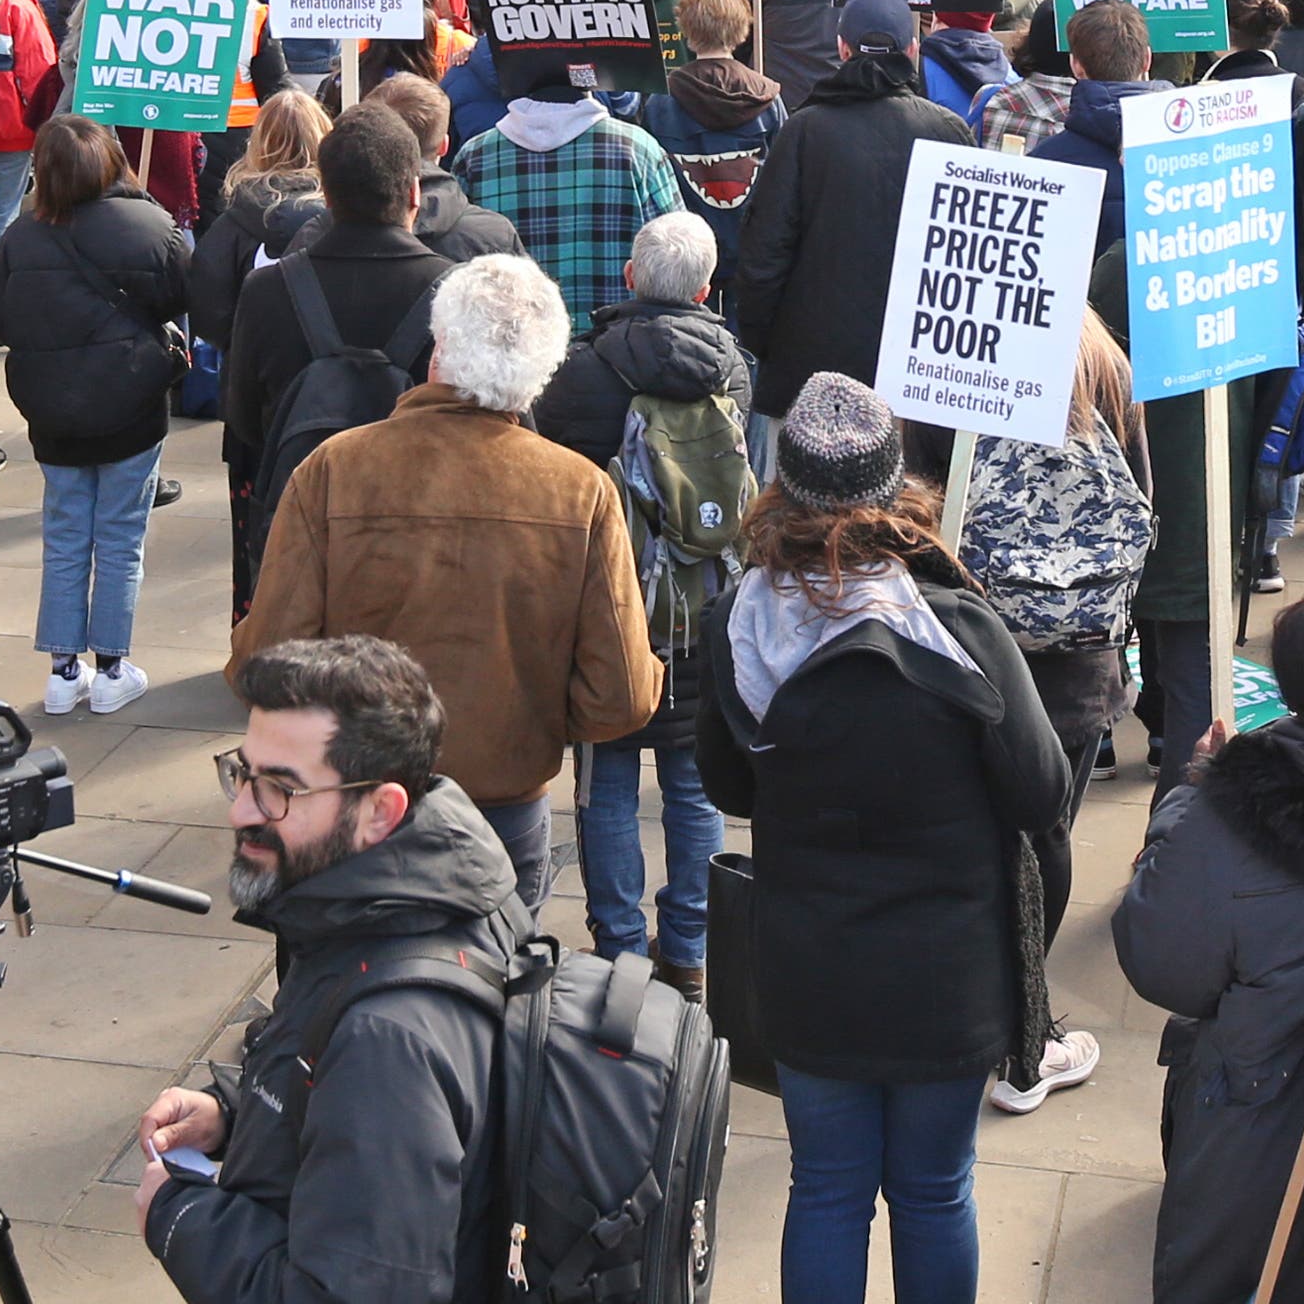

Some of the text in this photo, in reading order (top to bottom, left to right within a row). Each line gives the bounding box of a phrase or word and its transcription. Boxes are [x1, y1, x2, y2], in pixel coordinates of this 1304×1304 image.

[95, 14, 232, 69] NOT
[290, 13, 382, 31] and electricity
[492, 3, 651, 42] GOVERN
[92, 66, 220, 95] WELFARE
[1199, 90, 1253, 111] STAND UP
[1200, 104, 1257, 127] TO RACISM
[1145, 134, 1273, 177] Oppose Clause 9
[930, 182, 1048, 238] FREEZE
[1144, 163, 1275, 216] Scrap the
[924, 225, 1043, 287] PRICES,
[1135, 207, 1286, 265] Nationality
[917, 268, 1055, 328] NOT THE
[1146, 259, 1279, 311] & Borders
[910, 311, 1001, 363] POOR
[1196, 306, 1235, 349] Bill
[907, 356, 1043, 398] Renationalise gas
[903, 383, 1014, 420] and electricity
